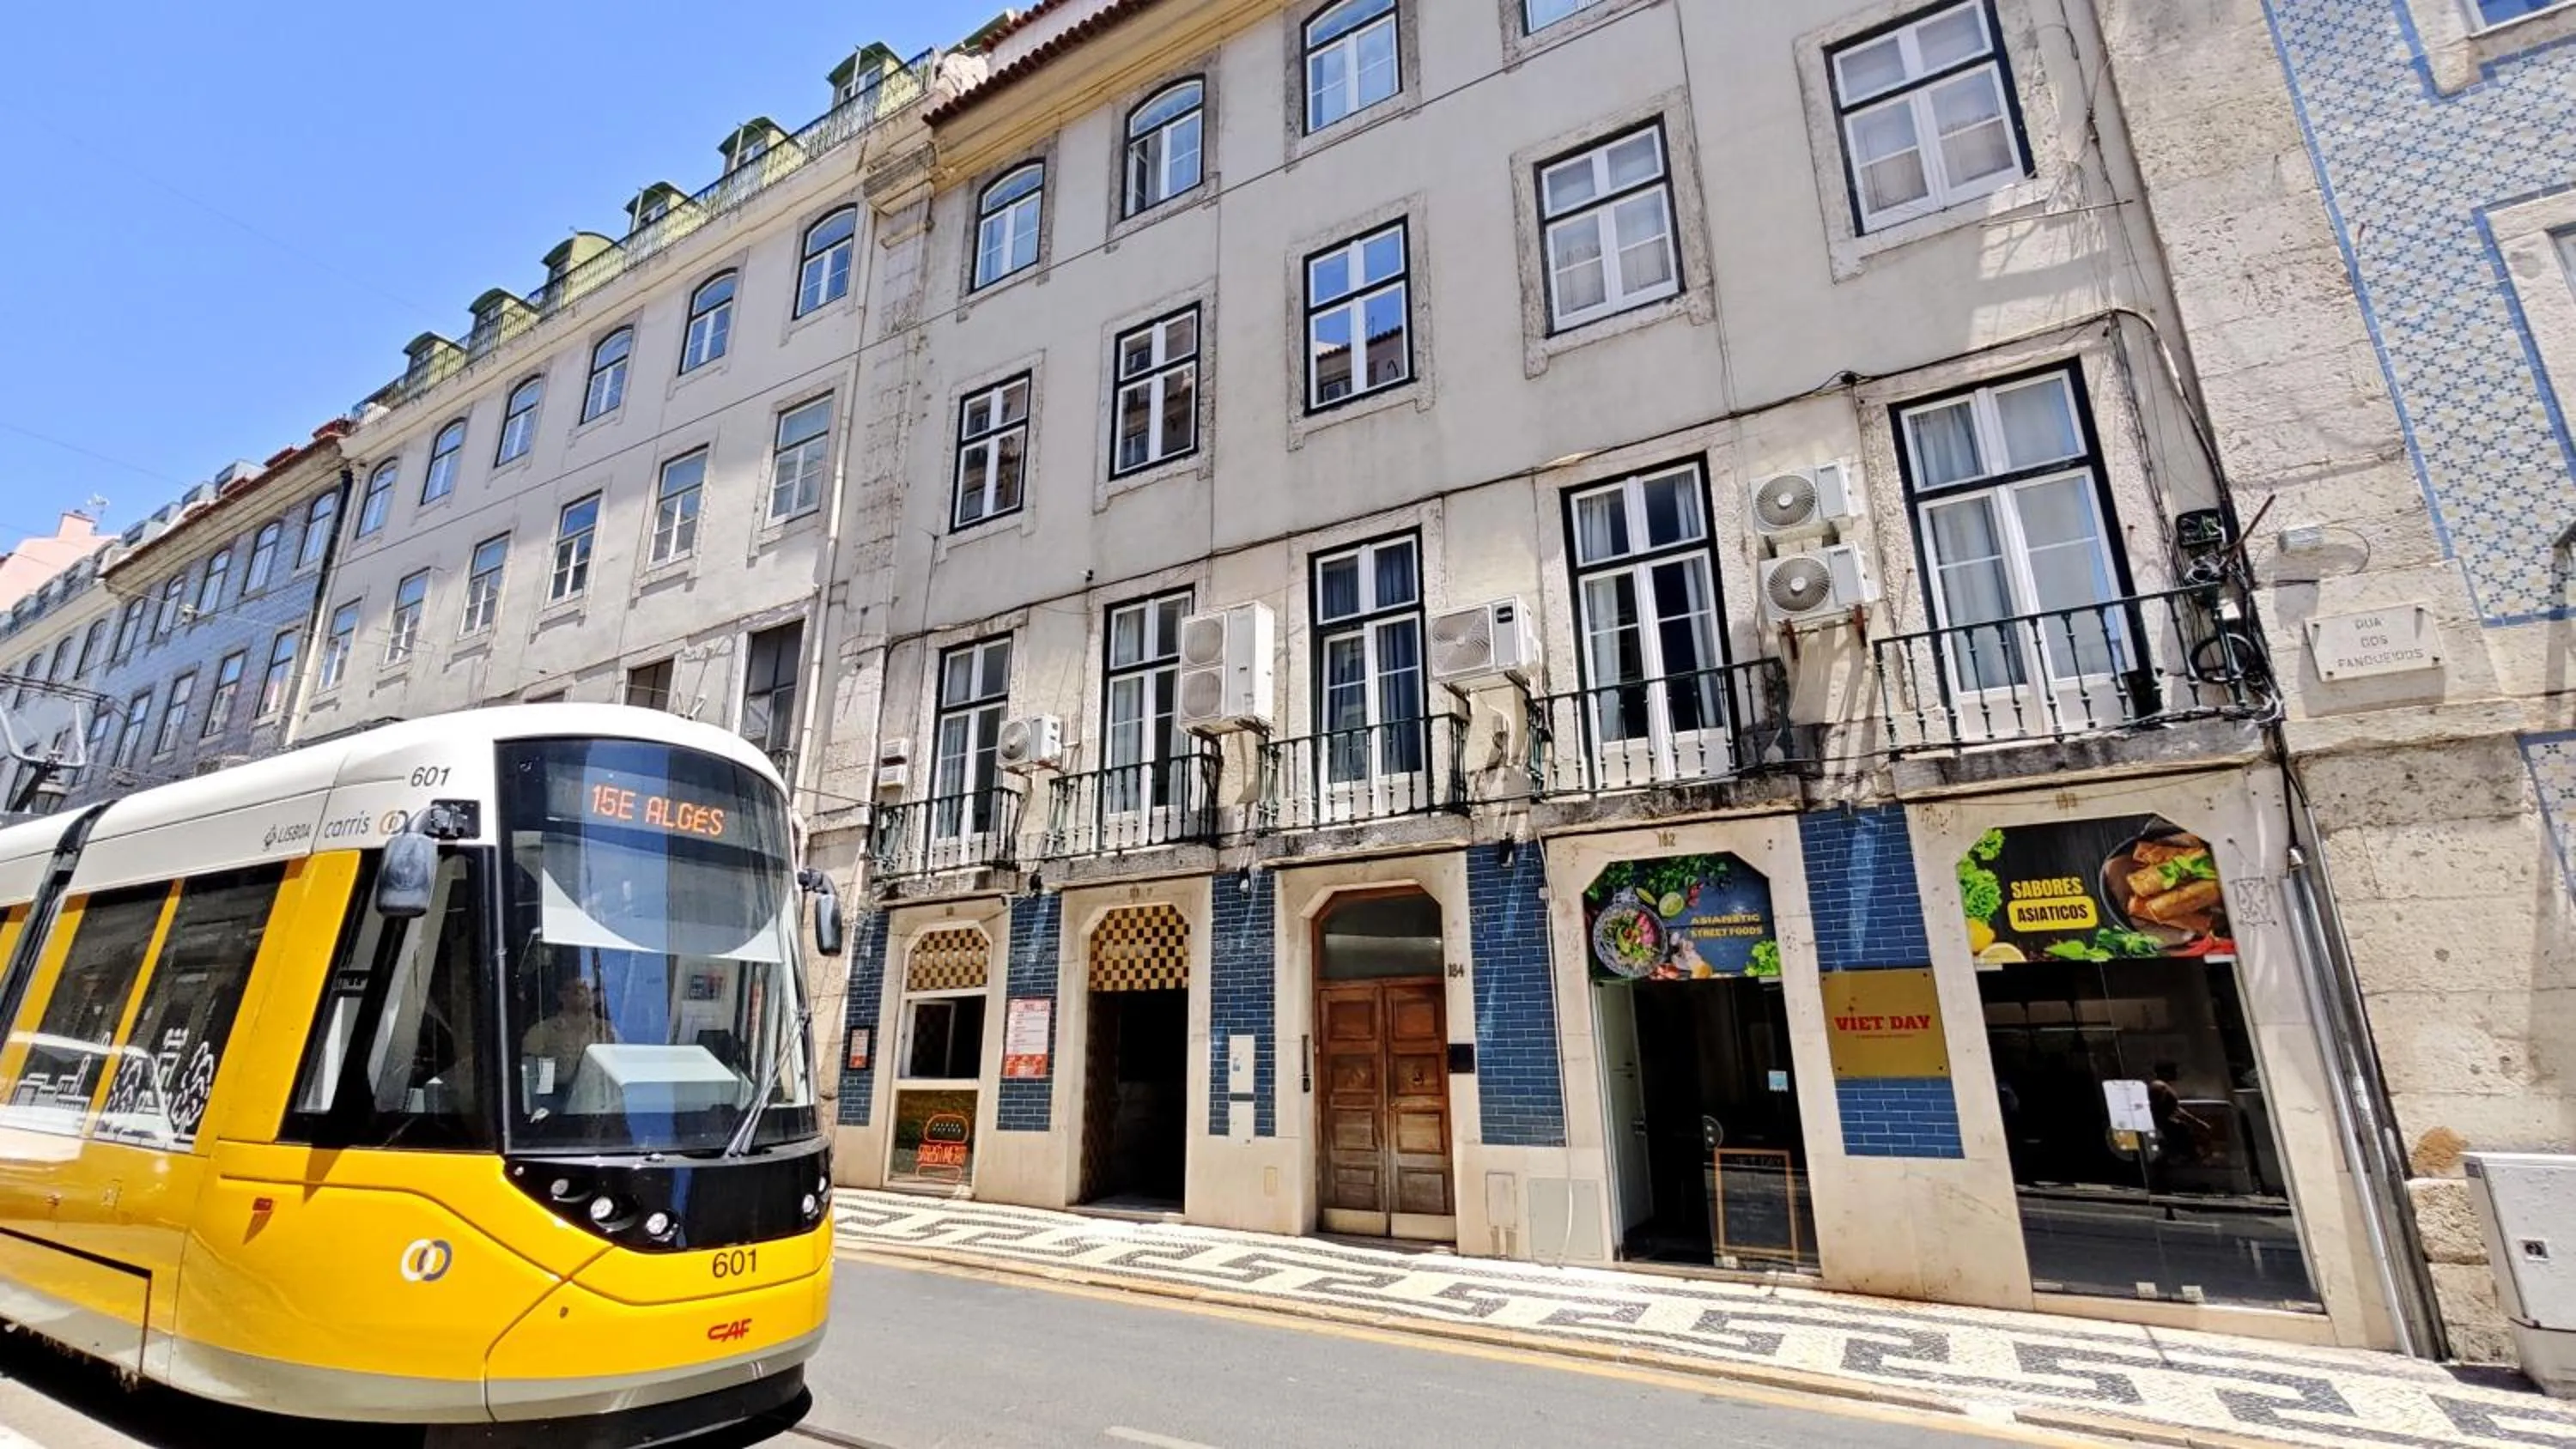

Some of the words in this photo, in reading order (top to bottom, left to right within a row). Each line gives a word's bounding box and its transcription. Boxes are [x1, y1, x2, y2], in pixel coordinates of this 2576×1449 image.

[411, 767, 451, 787] 601
[592, 784, 637, 821] 15E
[324, 810, 371, 839] carris
[2010, 876, 2084, 899] SABORES
[2017, 904, 2088, 923] ASIATICOS
[1729, 925, 1763, 936] FOODS
[1834, 1016, 1884, 1031] VIET
[1889, 1016, 1930, 1030] DAY
[713, 1247, 757, 1277] 601
[708, 1319, 753, 1343] CAF
